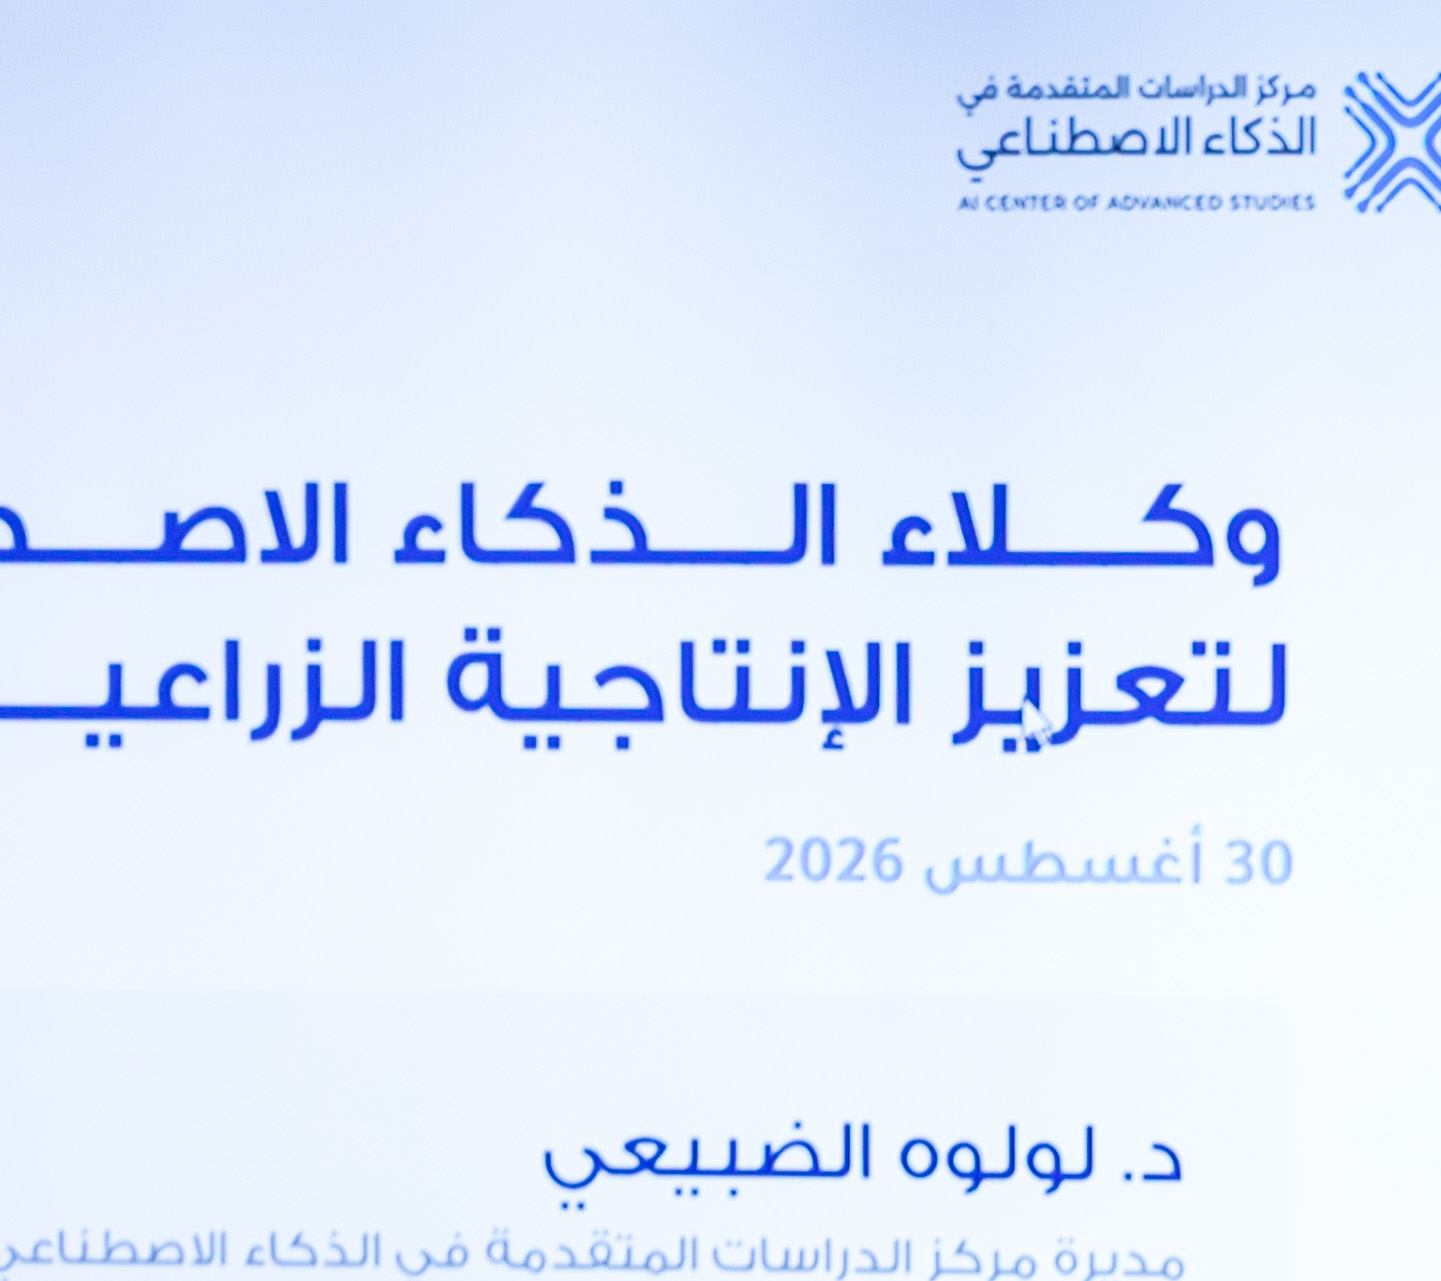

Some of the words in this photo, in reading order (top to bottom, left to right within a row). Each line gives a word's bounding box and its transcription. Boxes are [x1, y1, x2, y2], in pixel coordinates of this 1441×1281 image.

[957, 76, 999, 117] في
[1006, 75, 1130, 102] المتقدمة
[1138, 74, 1248, 106] الدراسات
[1255, 75, 1317, 106] مركز
[956, 115, 1192, 183] الاصطناعي
[1203, 115, 1316, 156] الذكاء
[958, 194, 980, 211] AI
[985, 194, 1067, 212] CENTER
[1073, 194, 1099, 212] OF
[1106, 194, 1223, 212] ADVANCED
[1229, 194, 1316, 212] STUDIES
[393, 480, 837, 566] الذكاء
[881, 482, 1281, 588] وكلاء
[0, 637, 405, 749] الزراعي
[446, 626, 911, 751] الإنتاجية
[952, 640, 1287, 754] لتعزيز
[765, 836, 904, 884] 2026
[923, 824, 1203, 897] أغسطس
[1226, 839, 1294, 886] 30
[544, 1121, 871, 1211] الضبيعي
[899, 1124, 1094, 1195] لولوه
[1123, 1143, 1182, 1182] د.
[244, 1231, 381, 1268] الذكاء
[485, 1230, 698, 1276] المتقدمة
[712, 1237, 912, 1281] الدراسات
